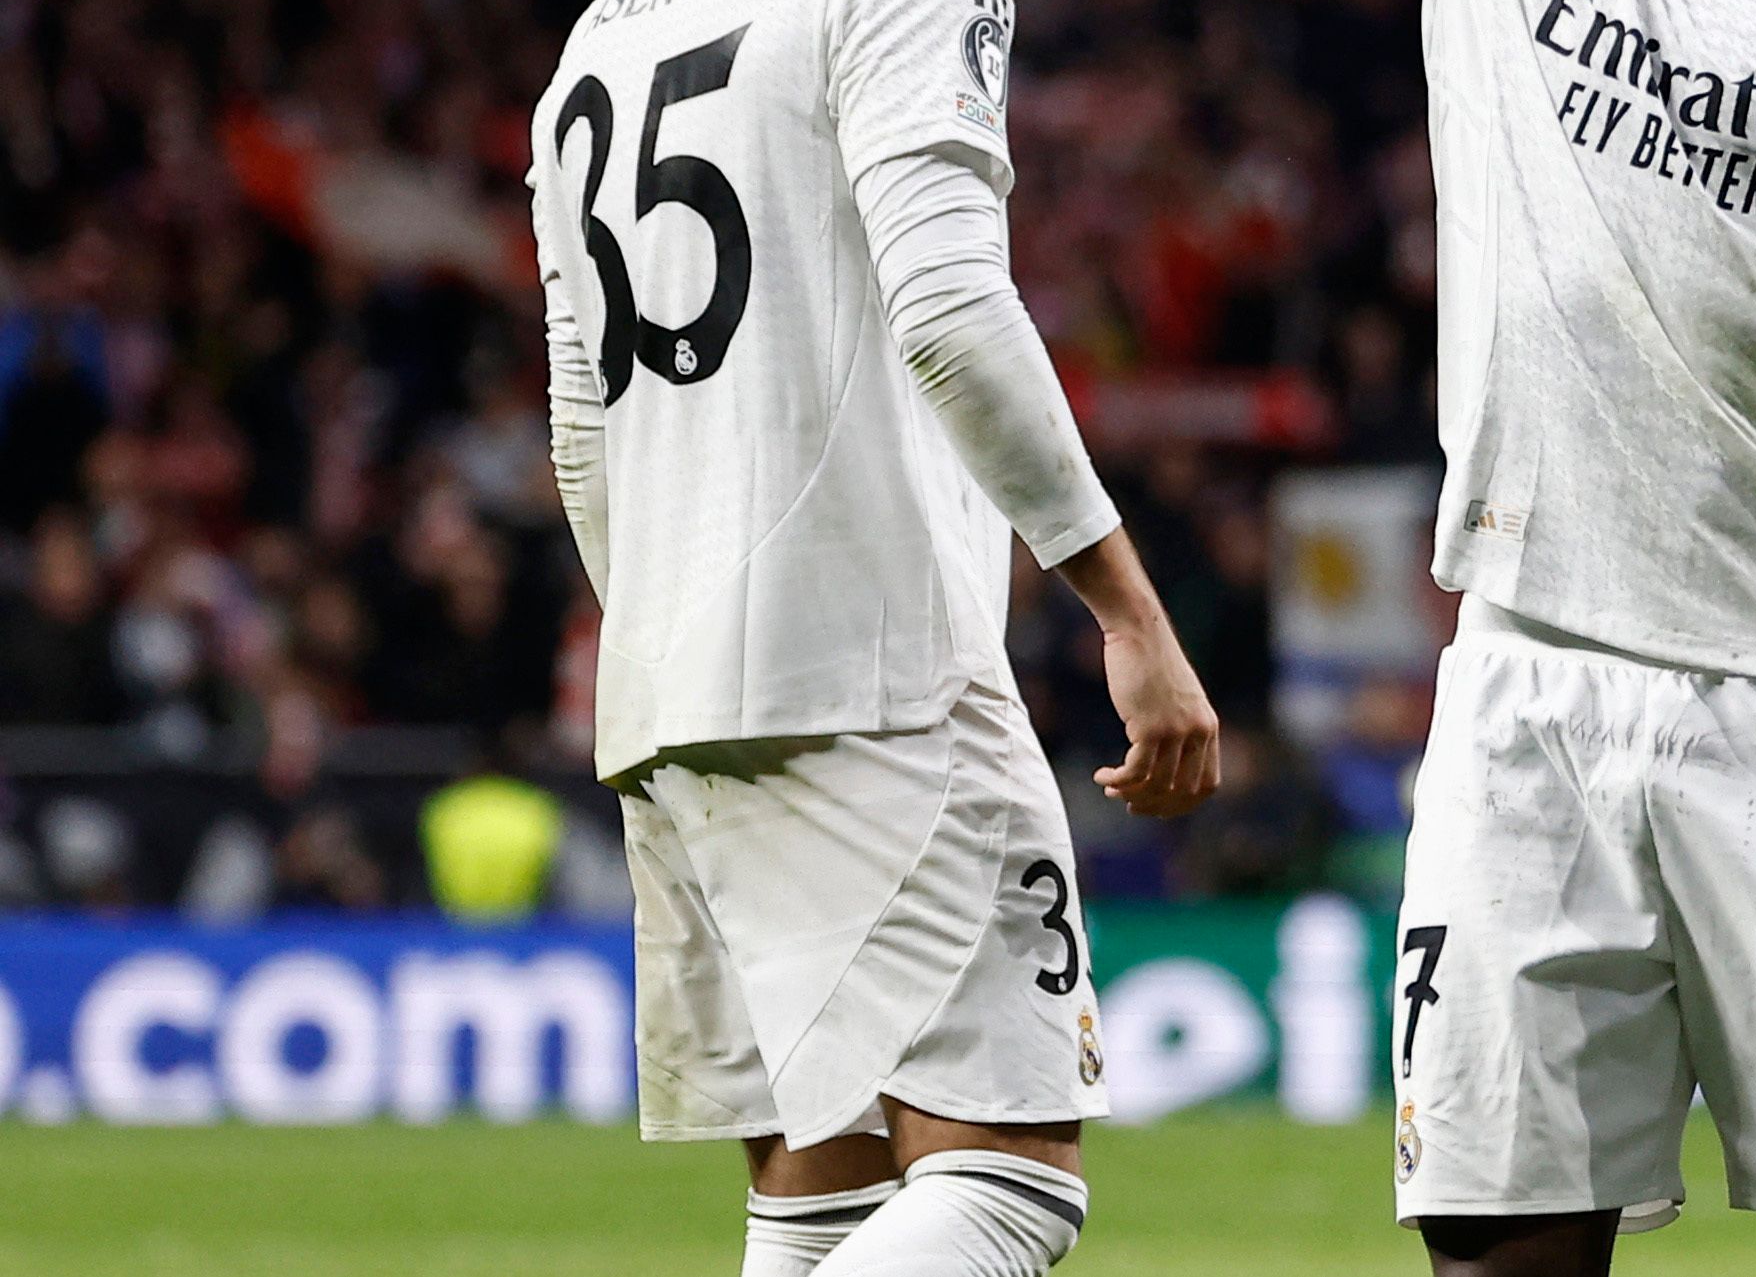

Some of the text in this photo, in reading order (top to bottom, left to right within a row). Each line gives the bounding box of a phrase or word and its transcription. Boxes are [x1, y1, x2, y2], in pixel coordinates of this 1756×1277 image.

[1558, 81, 1631, 154] FLY
[555, 22, 753, 410] 35
[1020, 859, 1079, 996] 3
[1403, 924, 1447, 1078] 7
[0, 950, 638, 1124] .com
